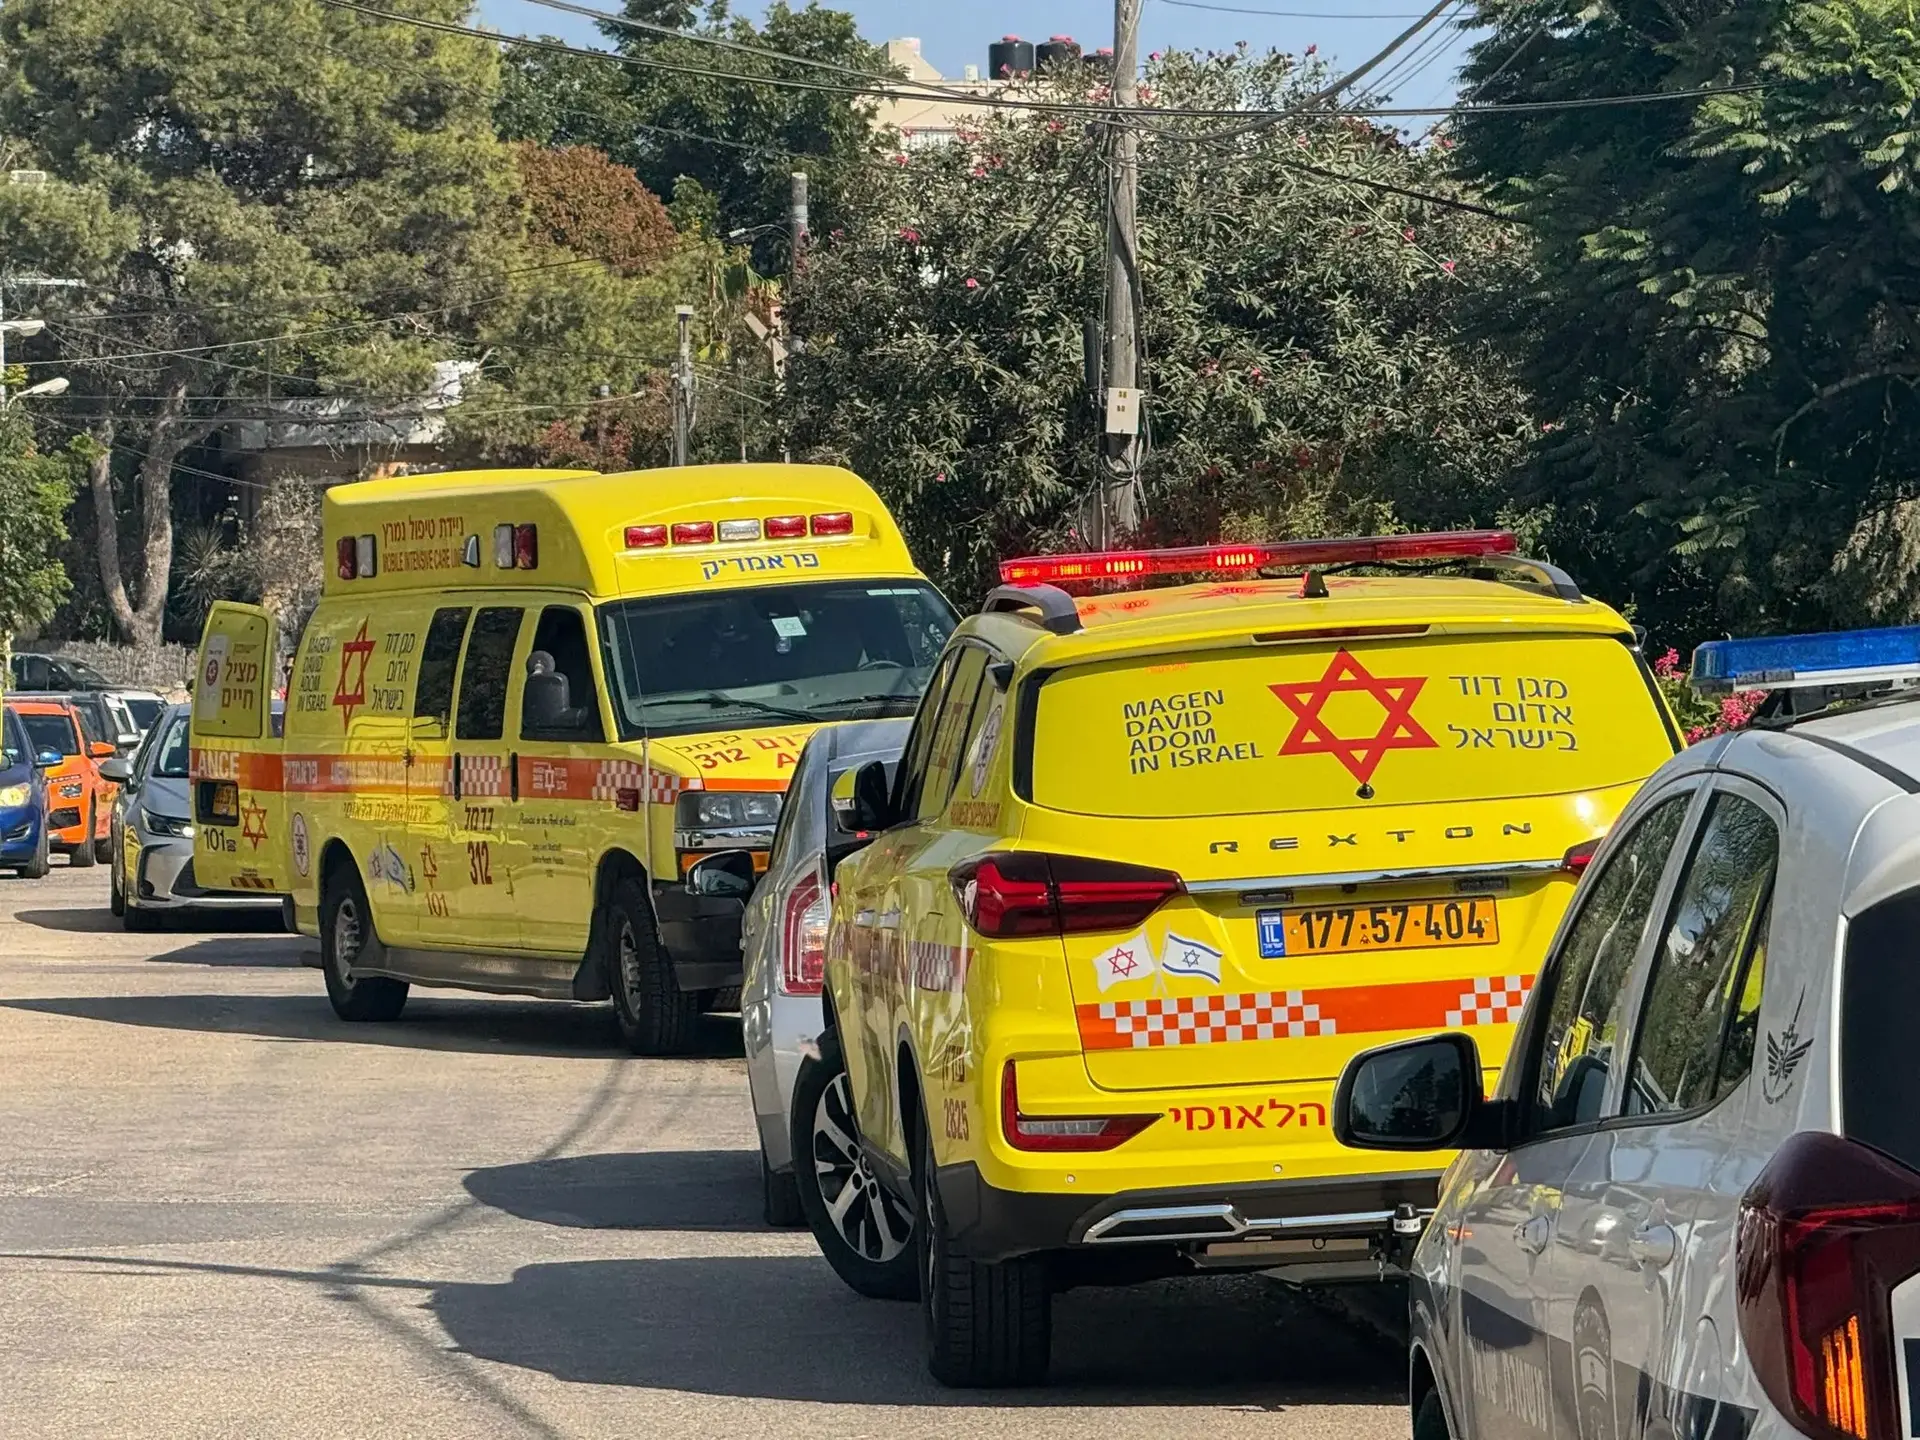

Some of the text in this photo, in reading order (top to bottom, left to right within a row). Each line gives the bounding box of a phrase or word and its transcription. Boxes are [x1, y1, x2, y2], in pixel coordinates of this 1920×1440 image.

[382, 514, 464, 549] ניידת טיפול נמרץ
[700, 553, 819, 580] פראמדיק
[307, 637, 333, 654] MAGEN
[385, 633, 416, 658] מגן דוד
[225, 656, 258, 683] מציל
[302, 655, 324, 673] DAVID
[386, 660, 411, 682] אדום
[300, 675, 321, 692] ADOM
[1448, 676, 1568, 701] מגן דוד
[222, 688, 254, 710] חיים
[297, 693, 328, 712] IN ISRAEL
[372, 684, 405, 711] בישראל
[1123, 689, 1224, 720] MAGEN
[1126, 710, 1212, 738] DAVID
[1493, 702, 1575, 726] אדום
[676, 734, 741, 753] כרמל
[1129, 728, 1217, 756] ADOM
[1447, 724, 1579, 751] בישראל
[189, 751, 240, 779] LANCE
[694, 748, 751, 770] 312
[1130, 742, 1264, 775] IN ISRAEL
[465, 802, 495, 831] כרמל
[204, 828, 226, 851] 101
[1209, 822, 1532, 854] REXTON
[467, 841, 493, 885] 312
[425, 891, 450, 917] 101
[1264, 925, 1280, 943] IL
[943, 1098, 969, 1141] 2825
[1168, 1098, 1326, 1131] הלאומי
